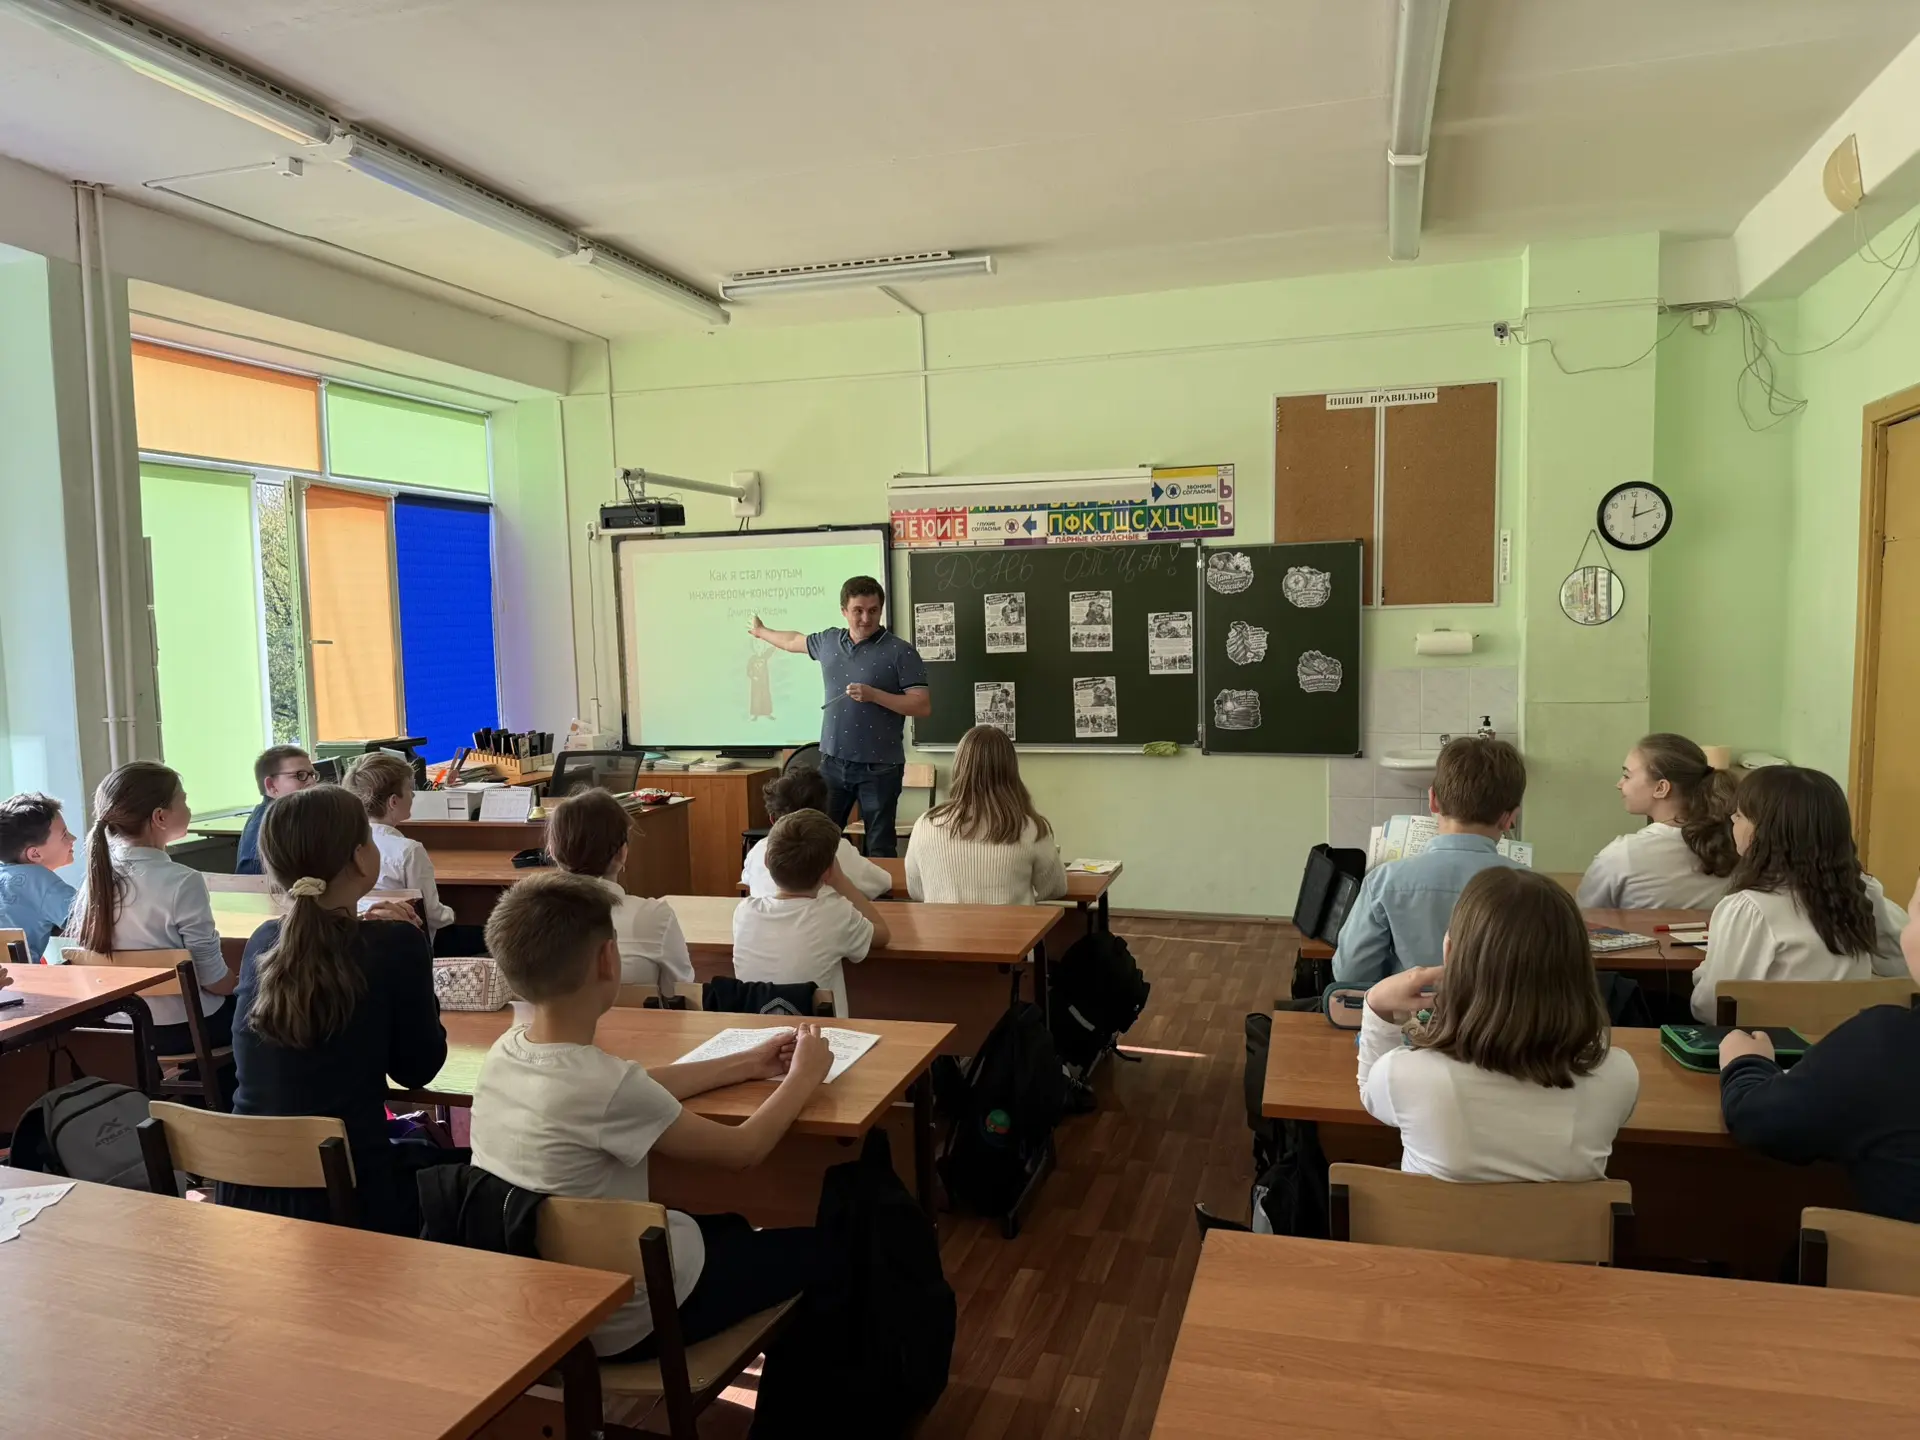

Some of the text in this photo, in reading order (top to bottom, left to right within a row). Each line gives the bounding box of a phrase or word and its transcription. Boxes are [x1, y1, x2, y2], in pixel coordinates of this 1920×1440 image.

[1330, 391, 1436, 406] ПИШИ ПРАВИЛЬНО
[1182, 488, 1217, 496] СОГЛАСНЫЕ
[1055, 533, 1140, 543] ПАРНЫЕ СОГЛАСНЫЕ
[709, 568, 803, 581] Как я стал крутым
[689, 585, 825, 601] инженером-конструктором
